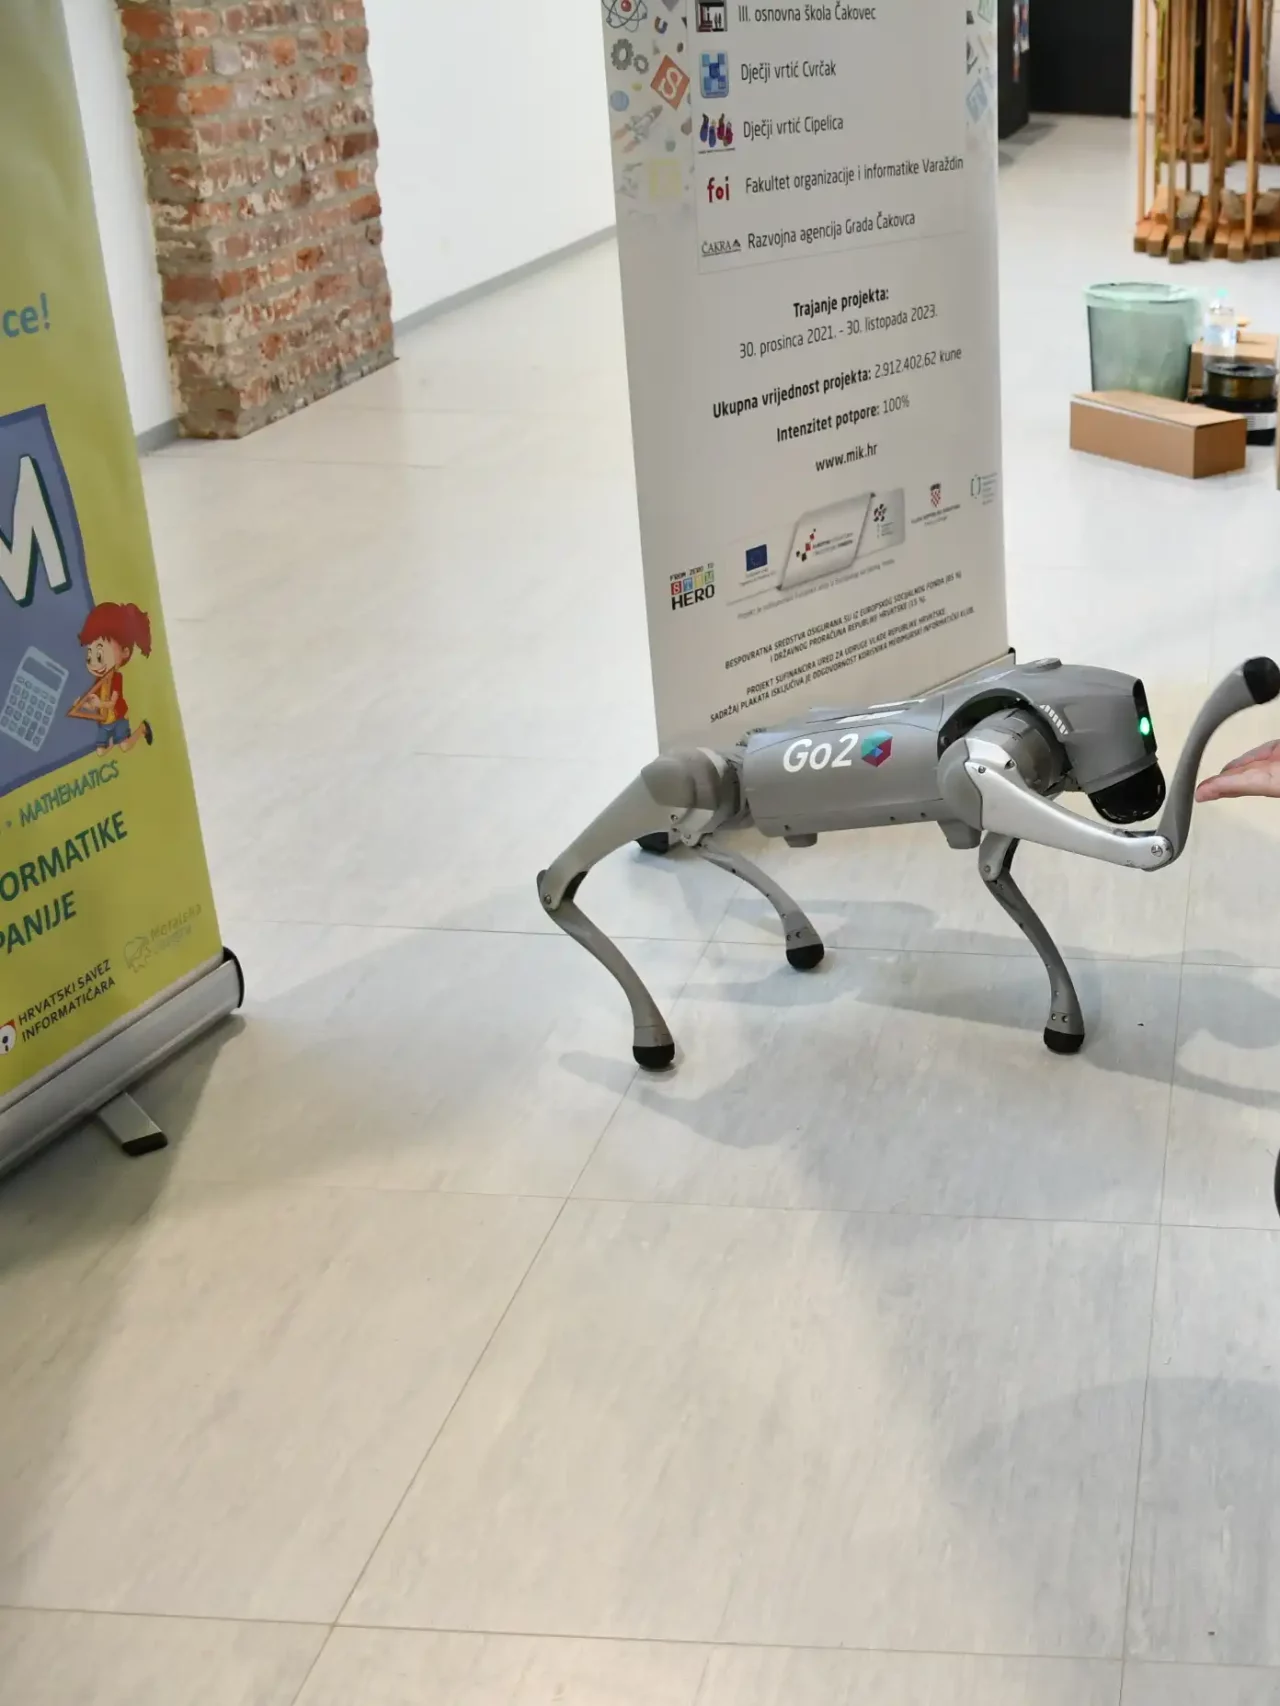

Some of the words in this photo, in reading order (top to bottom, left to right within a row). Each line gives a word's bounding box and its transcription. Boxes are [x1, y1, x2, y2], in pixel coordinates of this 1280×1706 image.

[755, 6, 800, 22] osnovna
[804, 3, 831, 21] škola
[834, 1, 877, 21] Čakovec
[741, 63, 771, 84] Dječji
[774, 62, 799, 79] vrtić
[802, 60, 837, 78] Cvrčak
[743, 120, 773, 141] Dječji
[776, 117, 801, 134] vrtić
[804, 115, 844, 135] Cipelica
[707, 176, 730, 203] foi
[745, 175, 790, 193] Fakultet
[793, 166, 855, 191] organizacije
[857, 165, 861, 180] i
[864, 160, 920, 180] informatike
[922, 155, 964, 173] Varaždin
[747, 228, 797, 249] Razvojna
[799, 221, 842, 244] agencija
[845, 216, 874, 234] Grada
[876, 211, 916, 230] Čakovca
[2, 293, 51, 337] ce!
[793, 296, 838, 319] Trajanje
[841, 288, 889, 312] projekta:
[739, 342, 757, 359] 30.
[760, 333, 804, 357] prosinca
[807, 325, 837, 344] 2021.
[846, 319, 863, 336] 30.
[865, 311, 908, 331] listopada
[911, 303, 938, 323] 2023.
[713, 396, 758, 419] Ukupna
[762, 379, 820, 407] vrijednost
[823, 369, 872, 393] projekta:
[939, 347, 962, 363] kune
[776, 415, 833, 442] Intenzitet
[835, 405, 880, 430] potpore:
[882, 394, 910, 415] 100%
[815, 442, 878, 472] www.mik.hr
[671, 584, 715, 610] HERO
[725, 644, 772, 669] BESPOVRATNA
[774, 631, 806, 650] SREDSTVA
[807, 617, 842, 637] OSIGURANA
[843, 614, 852, 623] SU
[774, 641, 808, 661] DRŽAVNOG
[809, 627, 846, 648] PRORAČUNA
[848, 614, 878, 632] REPUBLIKE
[710, 704, 739, 723] SADRŽAJ
[740, 691, 770, 710] PLAKATA
[771, 677, 804, 697] ISKLJUČIVA
[805, 673, 811, 684] JE
[812, 655, 857, 679] ODGOVORNOST
[858, 642, 887, 661] KORISNIKA
[746, 678, 774, 695] PROJEKT
[775, 661, 816, 684] SUFINANCIRA
[817, 653, 834, 666] URED
[835, 650, 843, 659] ZA
[844, 640, 868, 655] UDRUGE
[869, 631, 887, 645] VLADE
[782, 733, 859, 773] Go2
[19, 760, 119, 827] MATHEMATICS
[19, 981, 76, 1026] HRVATSKI
[77, 958, 111, 989] SAVEZ
